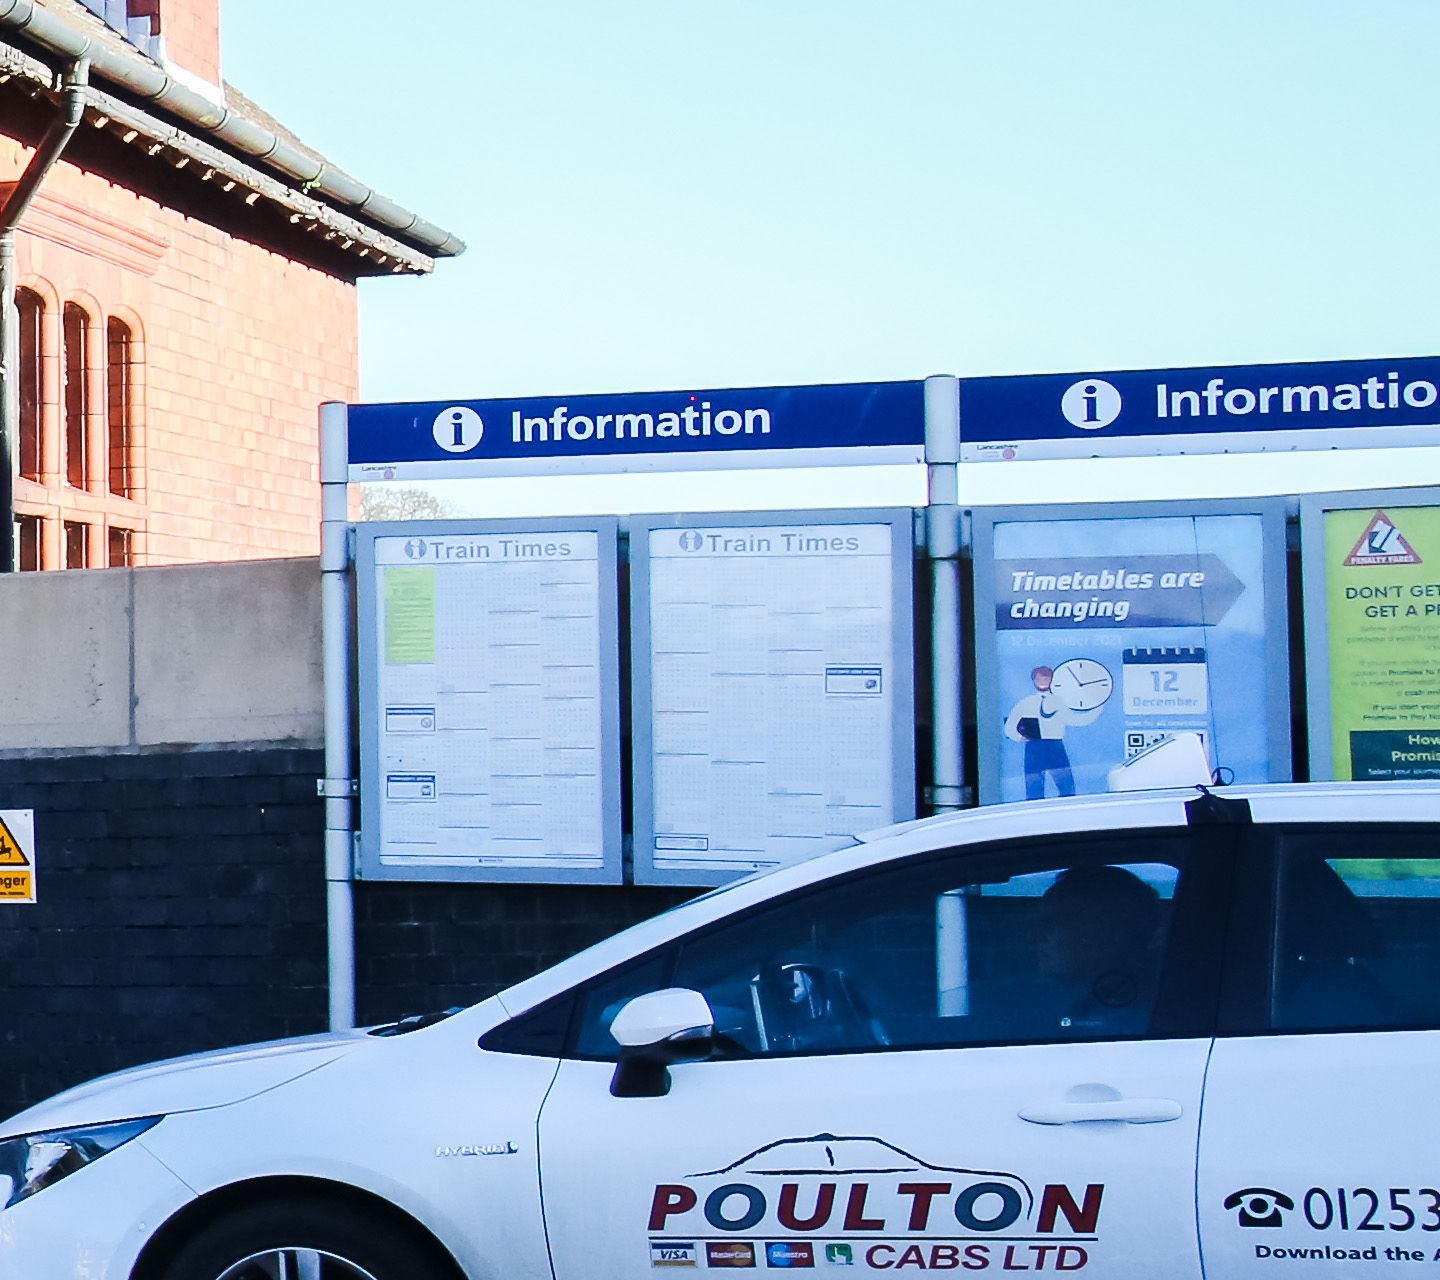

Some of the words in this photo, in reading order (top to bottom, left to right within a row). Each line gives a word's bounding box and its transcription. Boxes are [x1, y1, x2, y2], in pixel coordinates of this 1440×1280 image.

[1156, 371, 1440, 418] Informatio
[511, 402, 771, 443] Information
[429, 541, 491, 560] Train
[498, 539, 572, 558] Times
[708, 534, 771, 553] Train
[780, 532, 859, 552] Times
[1011, 568, 1154, 592] Timetables
[1159, 572, 1205, 589] are
[1345, 585, 1404, 600] DON'T
[1009, 597, 1131, 623] changing
[1365, 605, 1399, 618] GET
[1405, 604, 1419, 617] A
[1149, 670, 1179, 693] 12
[1133, 696, 1198, 708] December
[1391, 750, 1440, 763] Promis
[435, 1143, 506, 1158] HYBRID
[647, 1182, 1106, 1234] POULTON
[1303, 1187, 1440, 1232] 01253
[660, 1250, 689, 1260] VISA
[865, 1243, 991, 1271] CABS
[1002, 1243, 1089, 1271] LTD
[1255, 1244, 1378, 1261] Download
[1383, 1246, 1425, 1262] the
